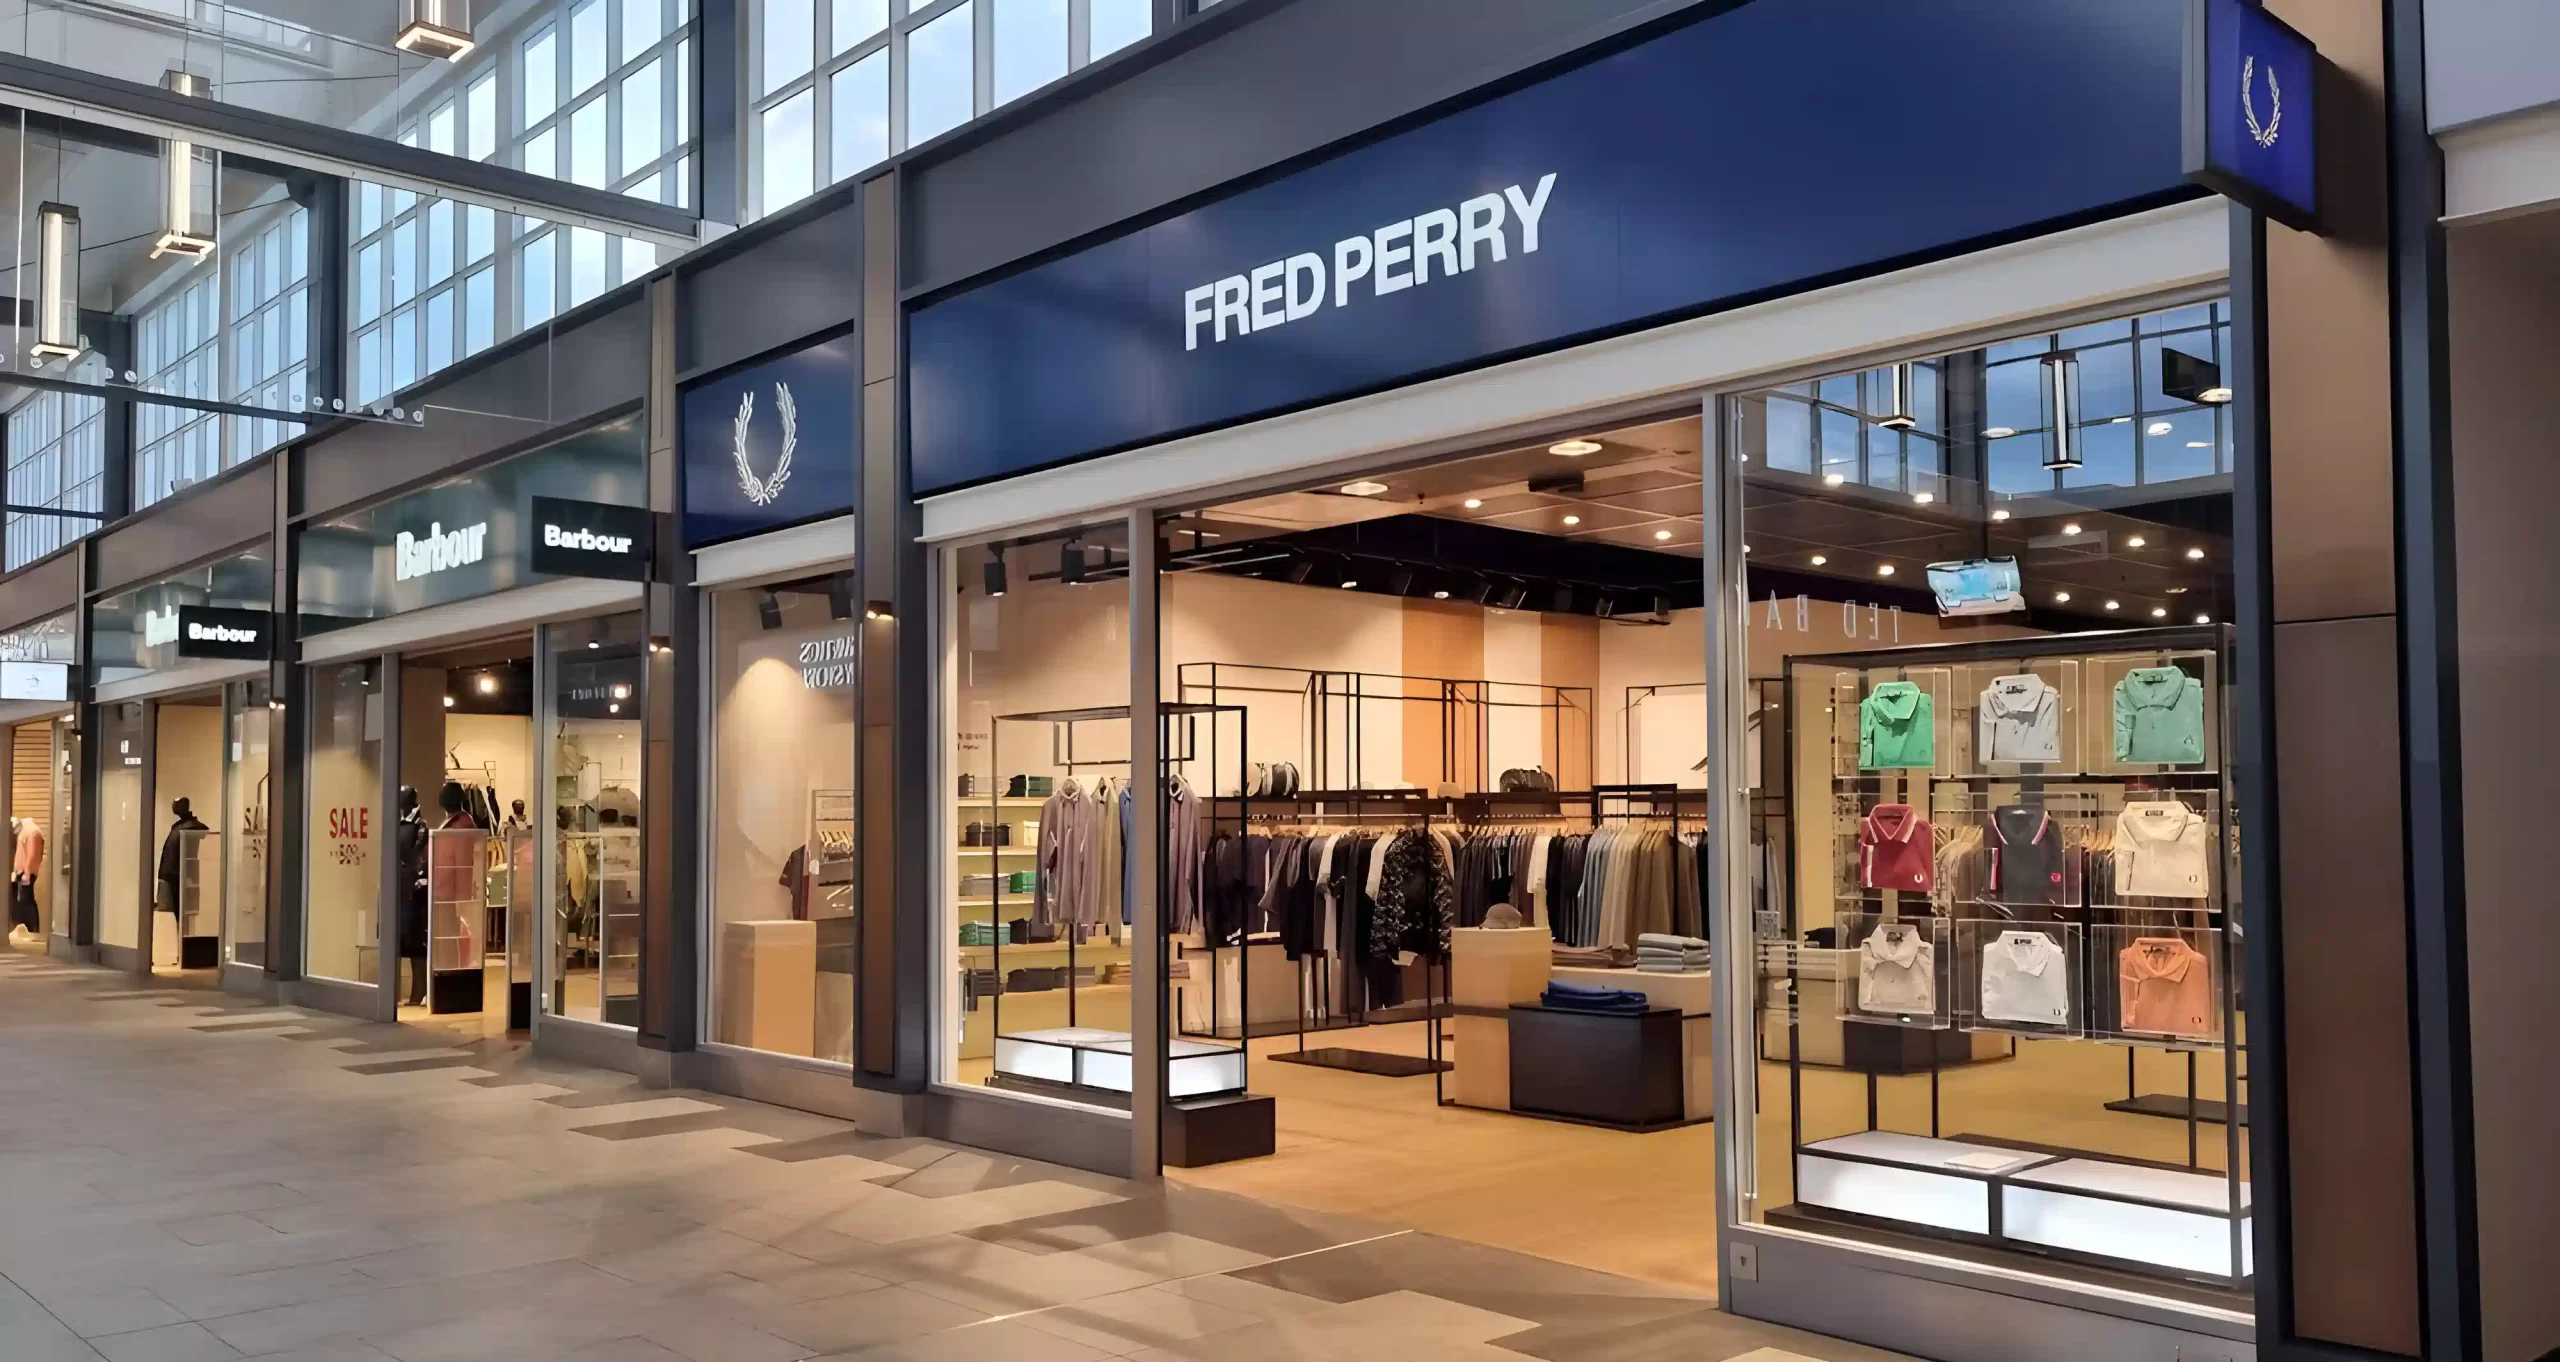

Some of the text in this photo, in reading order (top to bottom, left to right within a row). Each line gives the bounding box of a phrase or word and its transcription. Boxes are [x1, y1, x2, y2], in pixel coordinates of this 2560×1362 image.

[1185, 172, 1557, 350] FRED PERRY
[396, 522, 487, 581] Barbour
[544, 524, 632, 553] Barbour
[189, 623, 257, 642] Barbour
[329, 807, 368, 839] SALE
